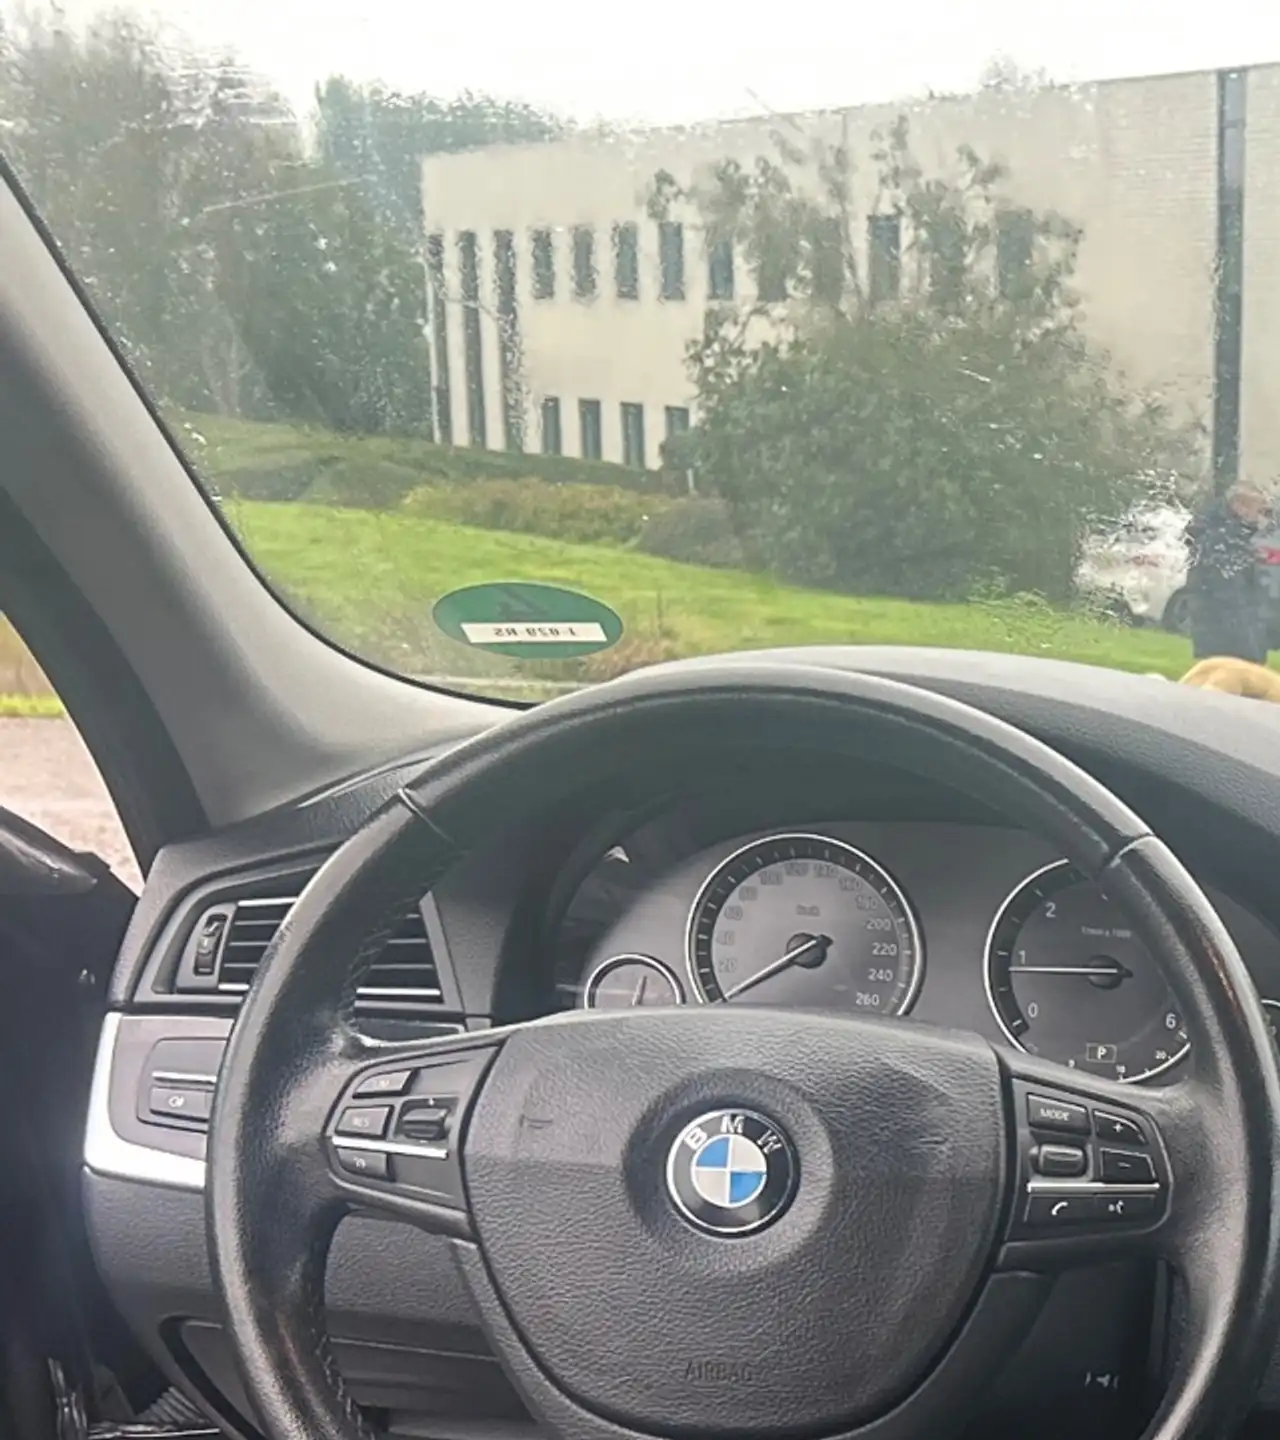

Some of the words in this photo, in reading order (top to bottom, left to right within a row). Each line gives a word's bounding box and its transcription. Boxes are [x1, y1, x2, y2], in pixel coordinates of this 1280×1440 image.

[1045, 902, 1056, 918] 2
[866, 917, 892, 931] 200
[872, 943, 898, 957] 220
[1017, 949, 1027, 965] 1
[868, 968, 893, 982] 240
[855, 991, 880, 1006] 260
[1028, 1002, 1038, 1018] 0
[1165, 1013, 1177, 1029] 6
[1097, 1046, 1107, 1060] P
[1039, 1107, 1072, 1122] MODE
[683, 1113, 783, 1154] BMW
